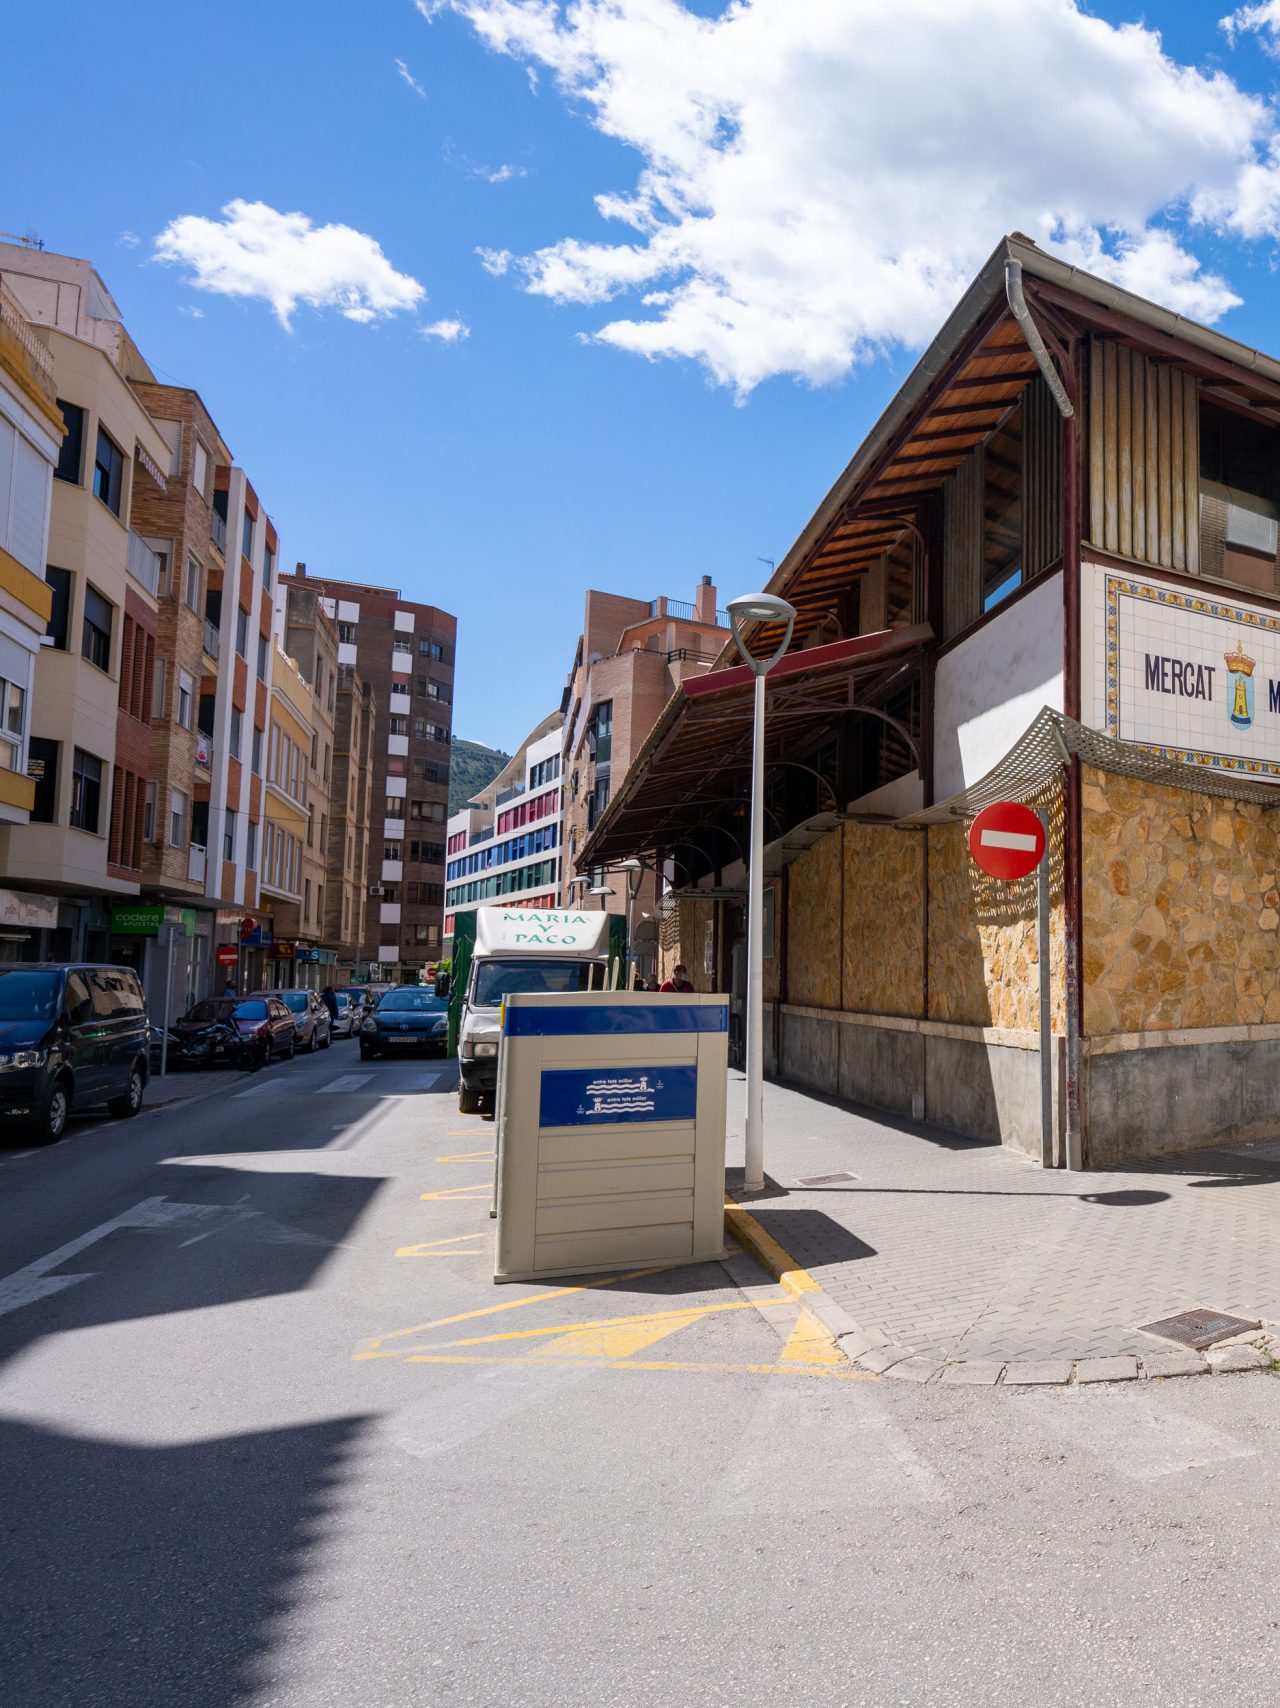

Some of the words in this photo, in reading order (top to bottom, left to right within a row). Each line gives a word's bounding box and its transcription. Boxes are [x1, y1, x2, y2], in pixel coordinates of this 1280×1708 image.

[1145, 653, 1216, 701] MERCAT
[115, 912, 160, 921] codere
[504, 912, 586, 924] MARIA
[538, 924, 555, 933] Y
[515, 933, 577, 944] PACO
